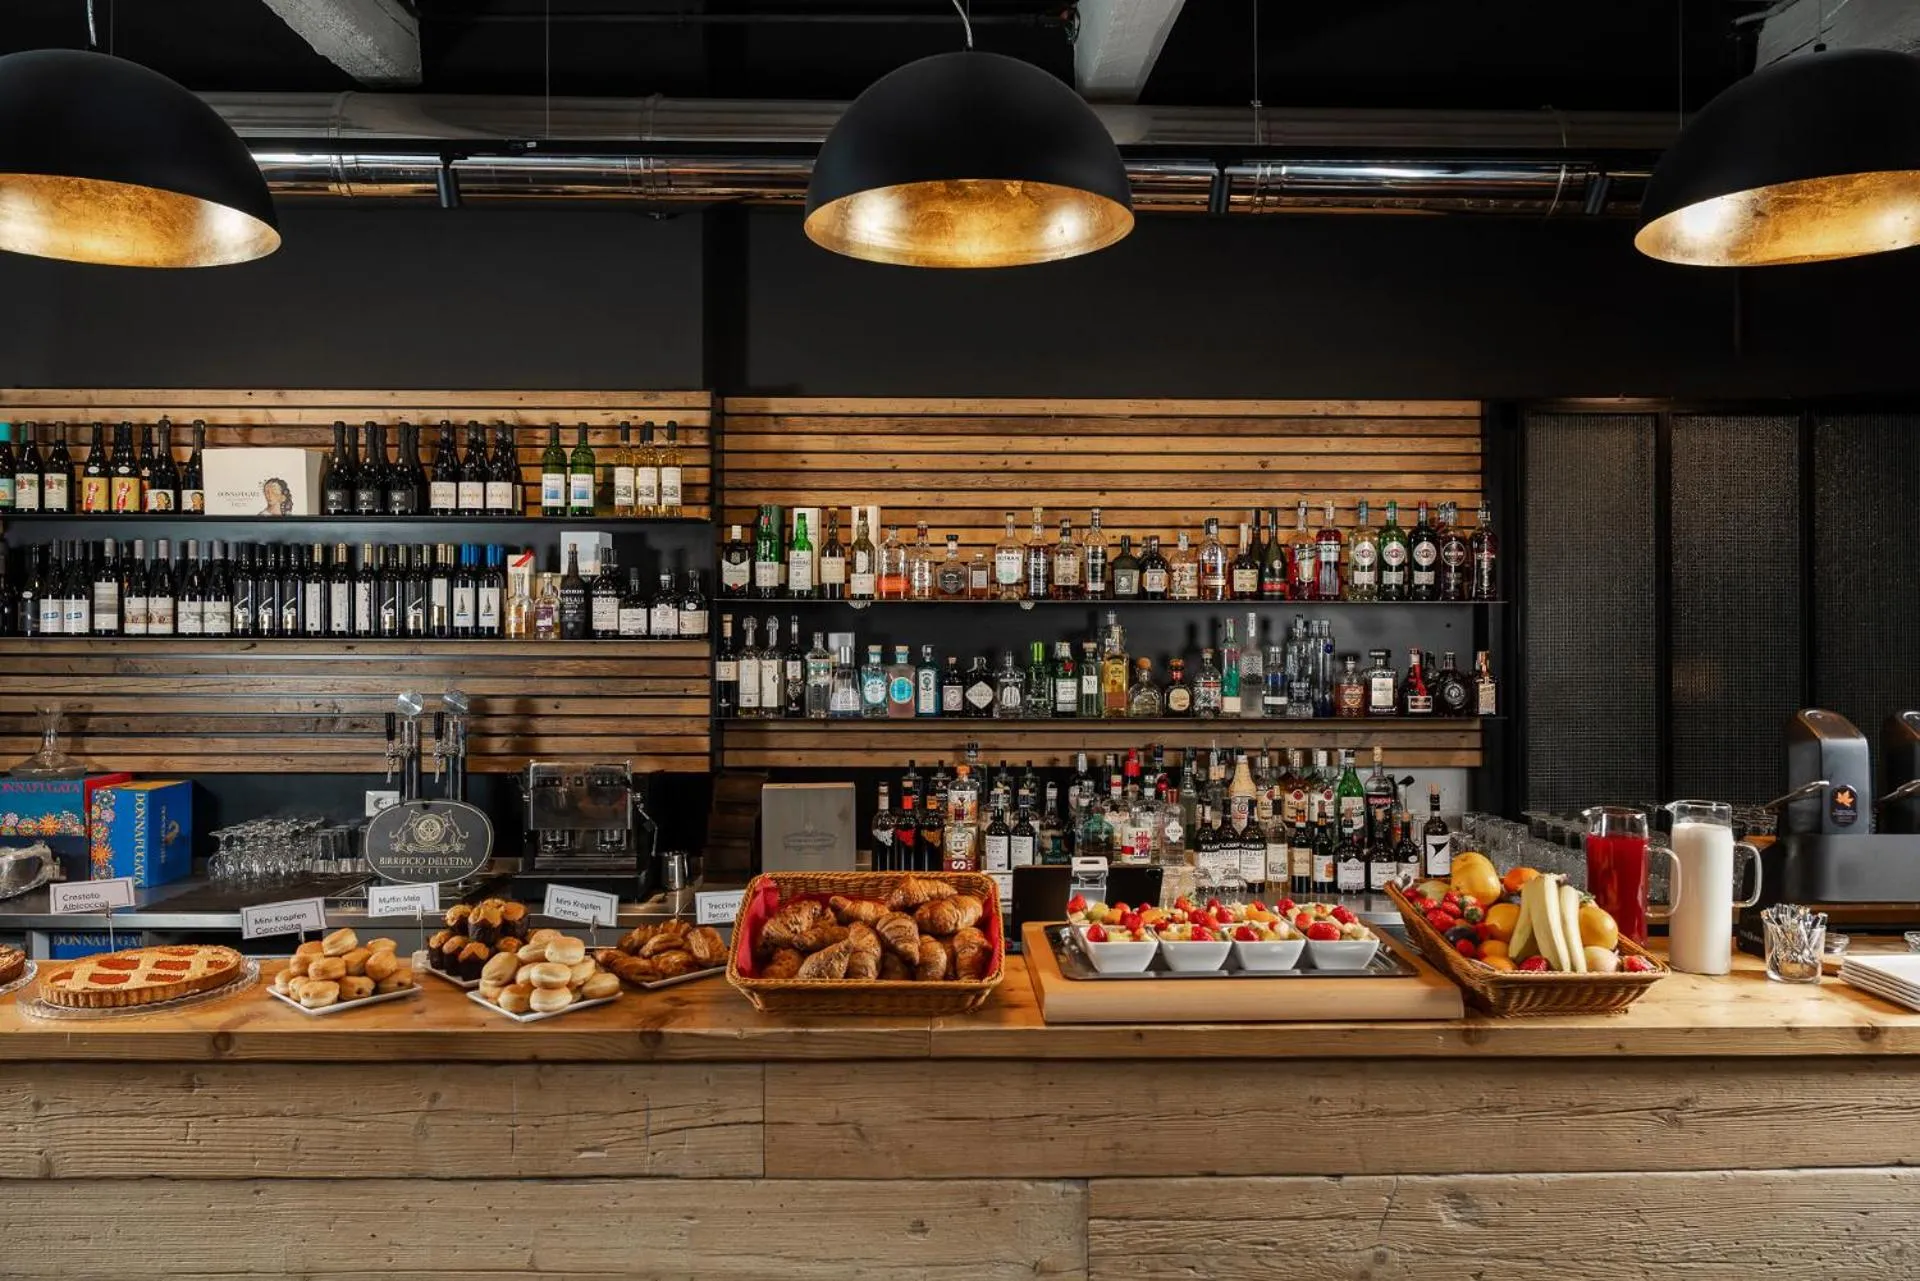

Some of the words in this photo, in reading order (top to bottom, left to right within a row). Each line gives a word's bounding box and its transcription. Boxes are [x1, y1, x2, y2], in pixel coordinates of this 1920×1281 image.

[1, 783, 80, 794] ONNAFUGATA
[134, 793, 146, 887] DONNAFUGATA
[951, 832, 966, 871] SKER
[379, 856, 426, 866] BIRRIFICIO
[254, 916, 273, 926] Mini
[274, 912, 307, 923] Krapfen
[255, 922, 302, 935] Cioccolato
